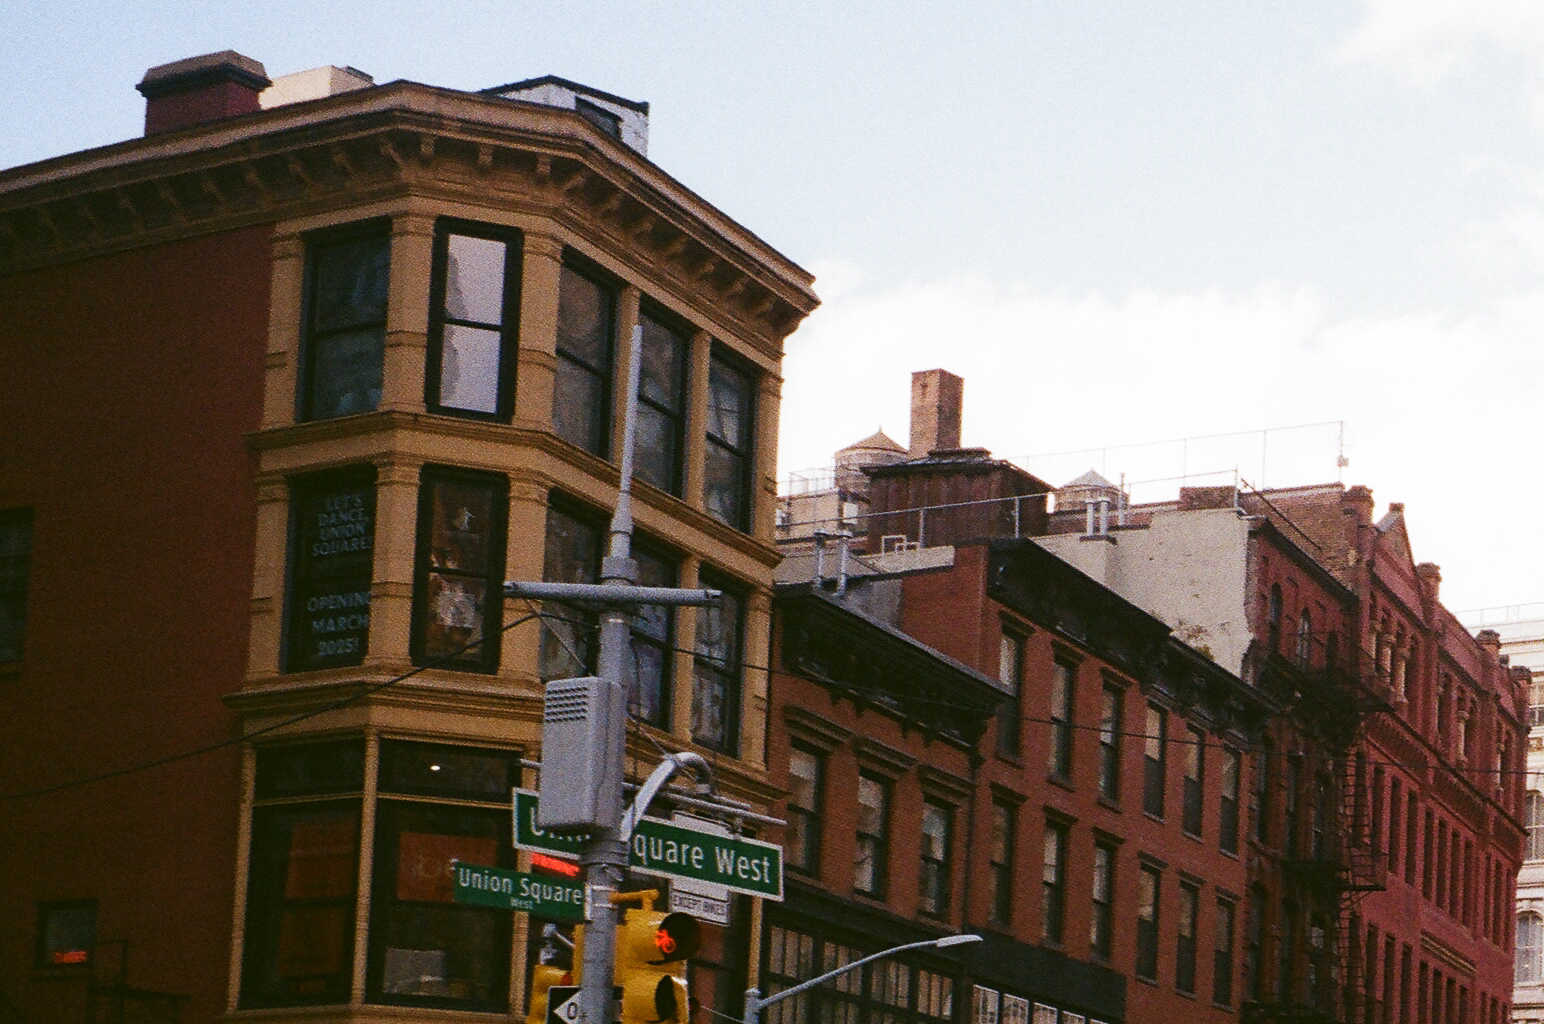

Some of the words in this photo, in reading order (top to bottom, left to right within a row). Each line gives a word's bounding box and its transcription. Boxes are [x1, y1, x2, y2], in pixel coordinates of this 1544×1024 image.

[320, 522, 366, 541] UNION
[311, 614, 369, 634] MARCH
[632, 832, 705, 870] quare
[715, 845, 771, 884] West
[458, 867, 512, 894] Union
[519, 876, 584, 906] Square
[510, 897, 534, 910] West
